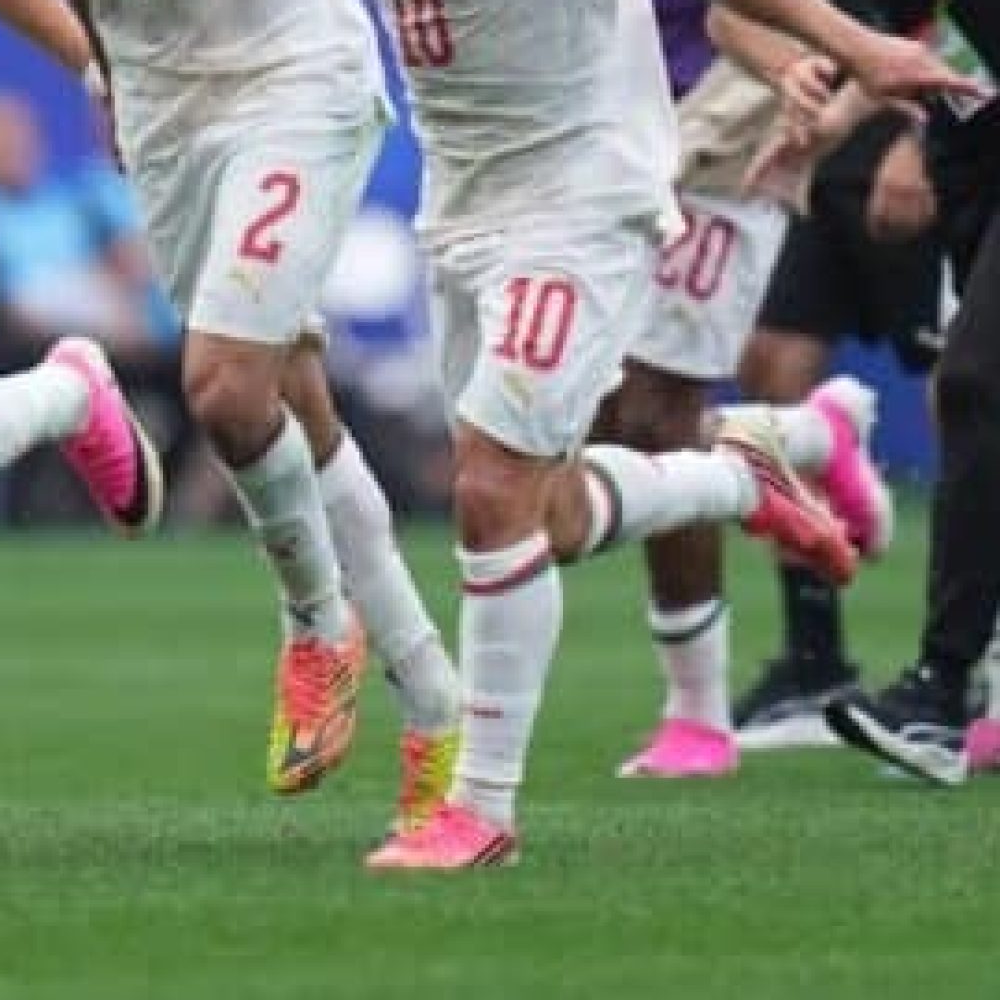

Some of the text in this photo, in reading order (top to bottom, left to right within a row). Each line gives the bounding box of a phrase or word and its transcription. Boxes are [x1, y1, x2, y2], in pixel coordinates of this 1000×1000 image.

[239, 174, 302, 263] 2
[655, 212, 737, 301] 20
[494, 277, 577, 370] 10
